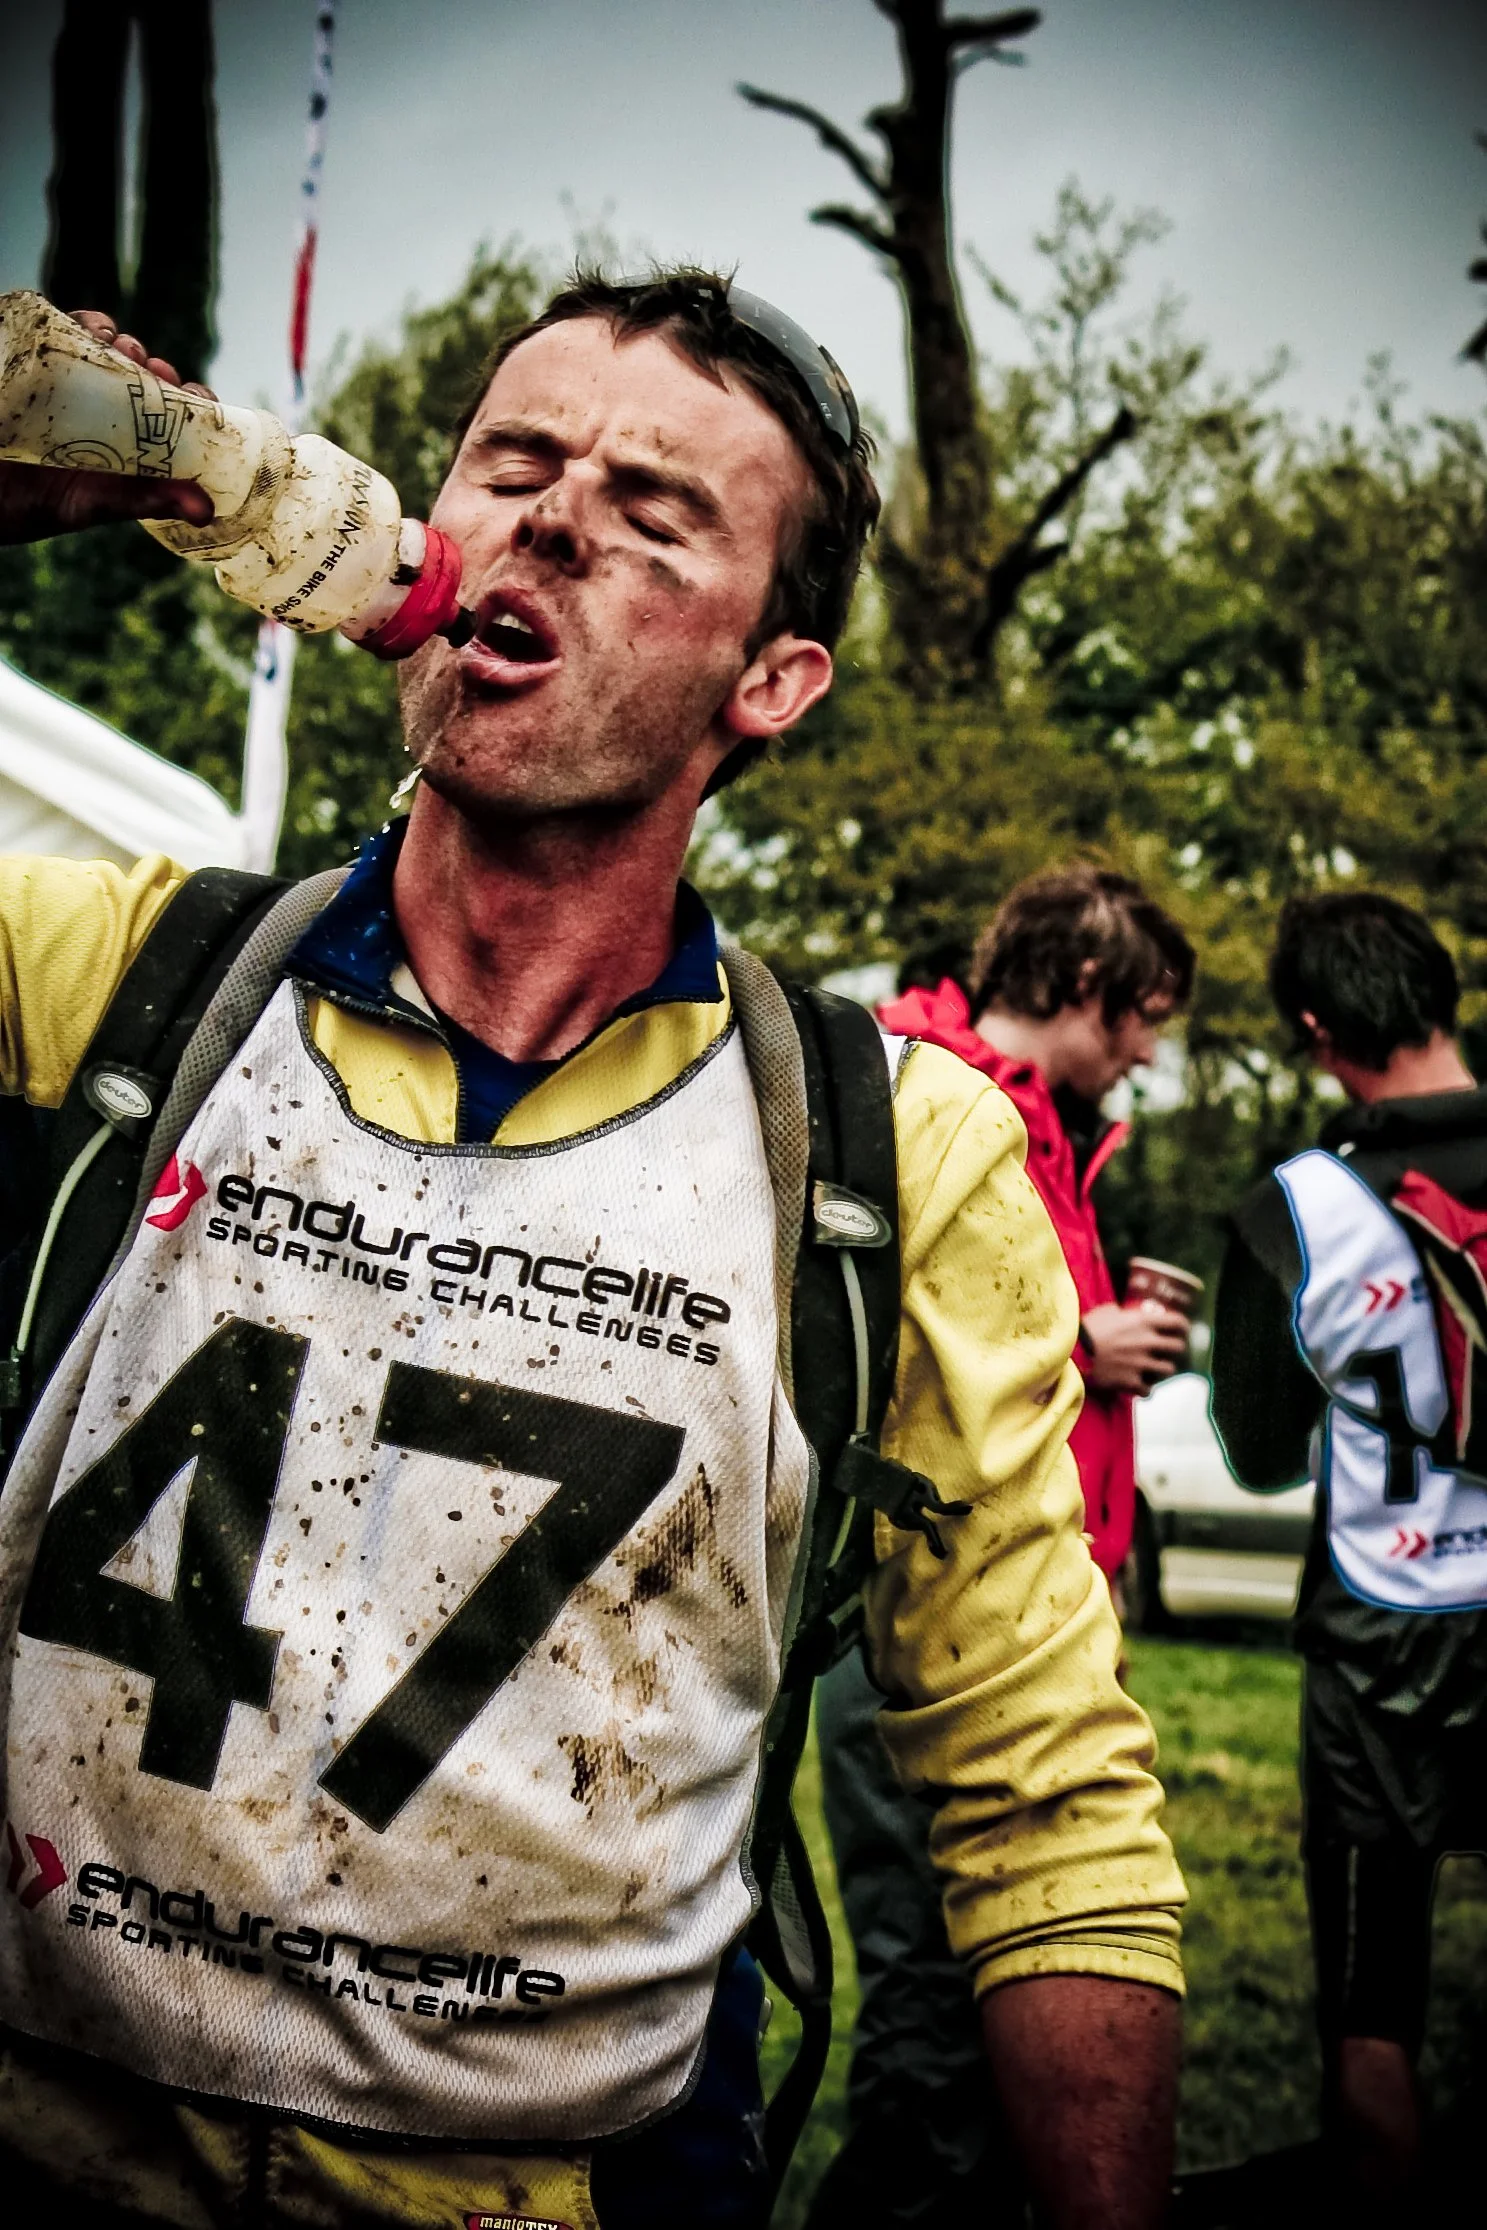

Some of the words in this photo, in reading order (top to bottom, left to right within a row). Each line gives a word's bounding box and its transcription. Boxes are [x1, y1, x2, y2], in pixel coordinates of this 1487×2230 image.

[297, 571, 327, 599] BIKE
[321, 545, 347, 572] THE
[206, 1217, 410, 1292] SPORTING
[430, 1280, 720, 1366] CHALLENGES
[217, 1174, 731, 1330] endurancelife
[18, 1316, 687, 1834] 47
[66, 1904, 264, 1974] SPORTING
[76, 1862, 566, 2006] endurancelife
